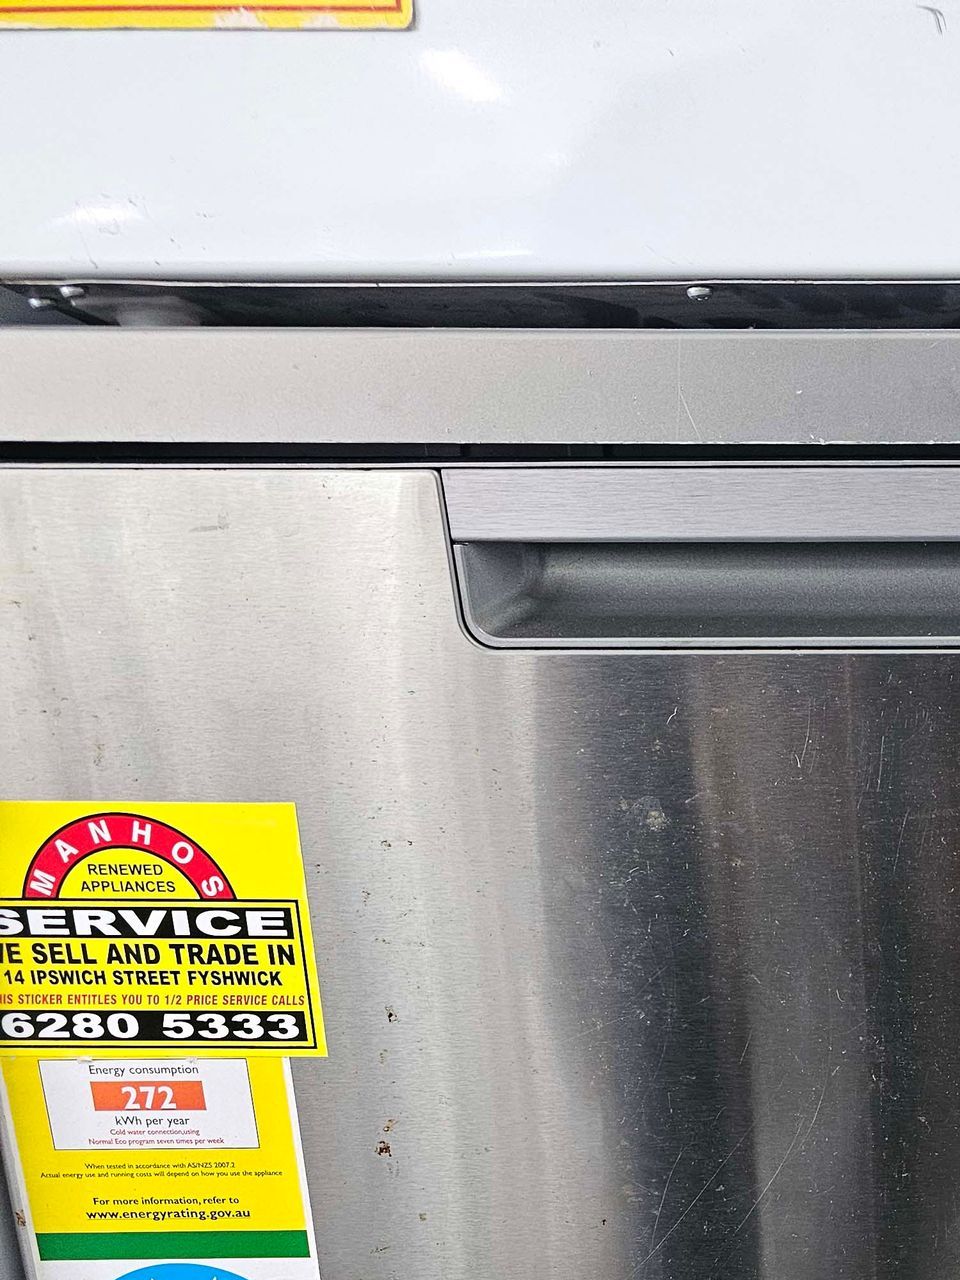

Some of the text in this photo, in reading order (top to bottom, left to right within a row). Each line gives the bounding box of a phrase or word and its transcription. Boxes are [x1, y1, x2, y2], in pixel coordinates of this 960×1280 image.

[30, 819, 224, 897] MANHOS
[88, 863, 163, 876] RENEWED
[81, 880, 176, 893] APPLIANCES
[0, 909, 288, 936] SERVICE
[0, 943, 295, 966] E SELL AND TRADE IN
[4, 970, 282, 986] 14 IPSWICH STREET FYSHWICK
[18, 993, 63, 1005] STICKER
[67, 994, 117, 1005] ENTITLES
[122, 994, 142, 1005] YOU
[147, 994, 160, 1005] TO
[165, 995, 181, 1006] 1/2
[187, 995, 218, 1006] PRICE
[222, 995, 267, 1006] SERVICE
[271, 995, 305, 1006] CALLS
[1, 1012, 300, 1040] 6280 5333
[89, 1065, 199, 1078] Energy consumption
[121, 1085, 177, 1110] 272
[115, 1115, 190, 1128] kWh per year
[110, 1128, 126, 1136] Cold
[128, 1138, 155, 1146] program
[176, 1137, 193, 1145] times
[93, 1197, 109, 1205] For
[141, 1196, 202, 1206] information,
[203, 1196, 226, 1204] refer
[86, 1208, 251, 1221] www.energyrating.gov.au
